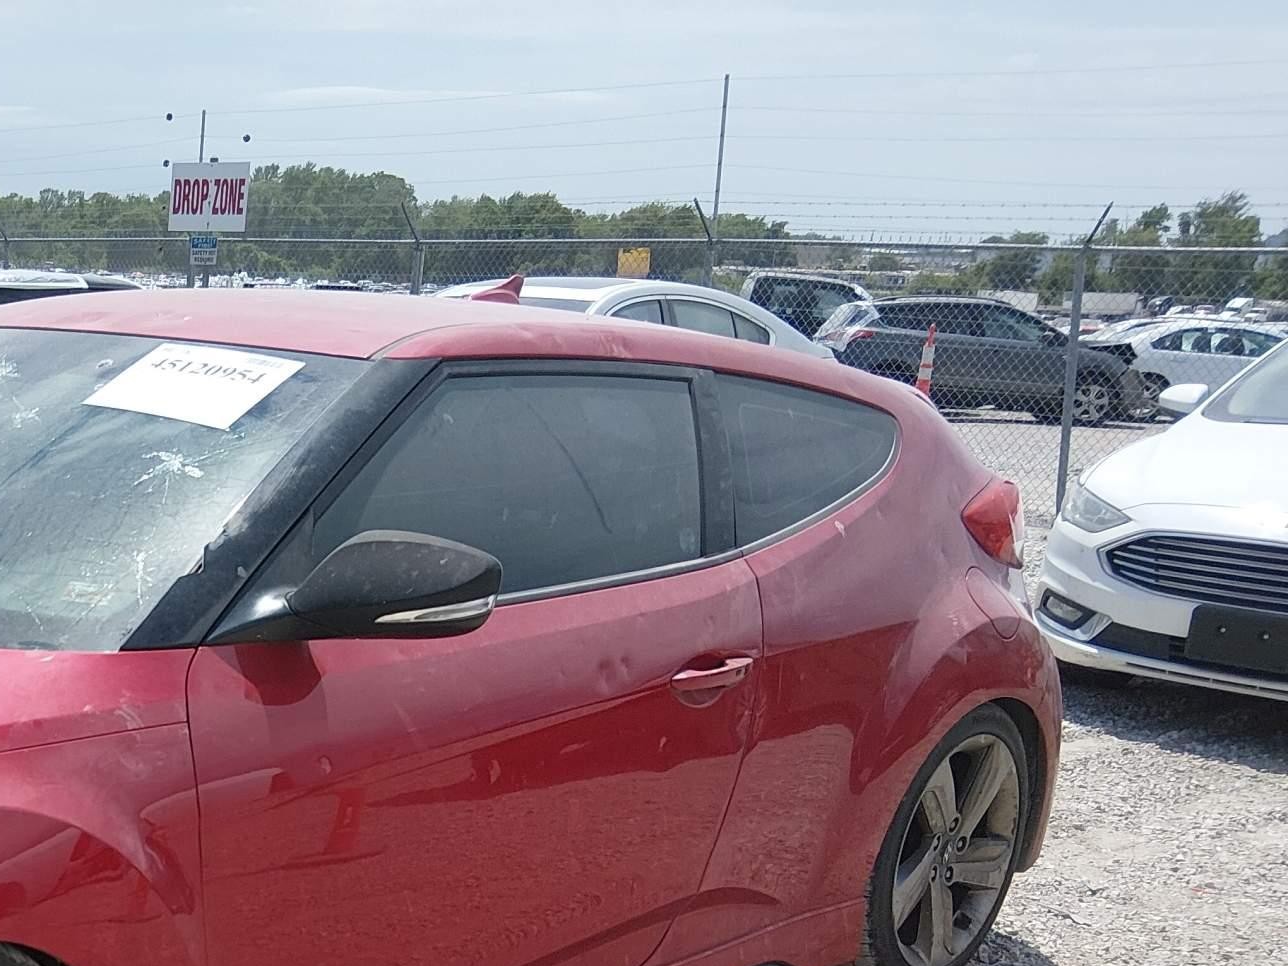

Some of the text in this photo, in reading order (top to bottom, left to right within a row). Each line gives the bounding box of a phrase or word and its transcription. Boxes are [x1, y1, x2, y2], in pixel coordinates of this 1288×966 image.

[172, 178, 245, 215] DROP ZONE
[152, 358, 267, 384] 45120954
